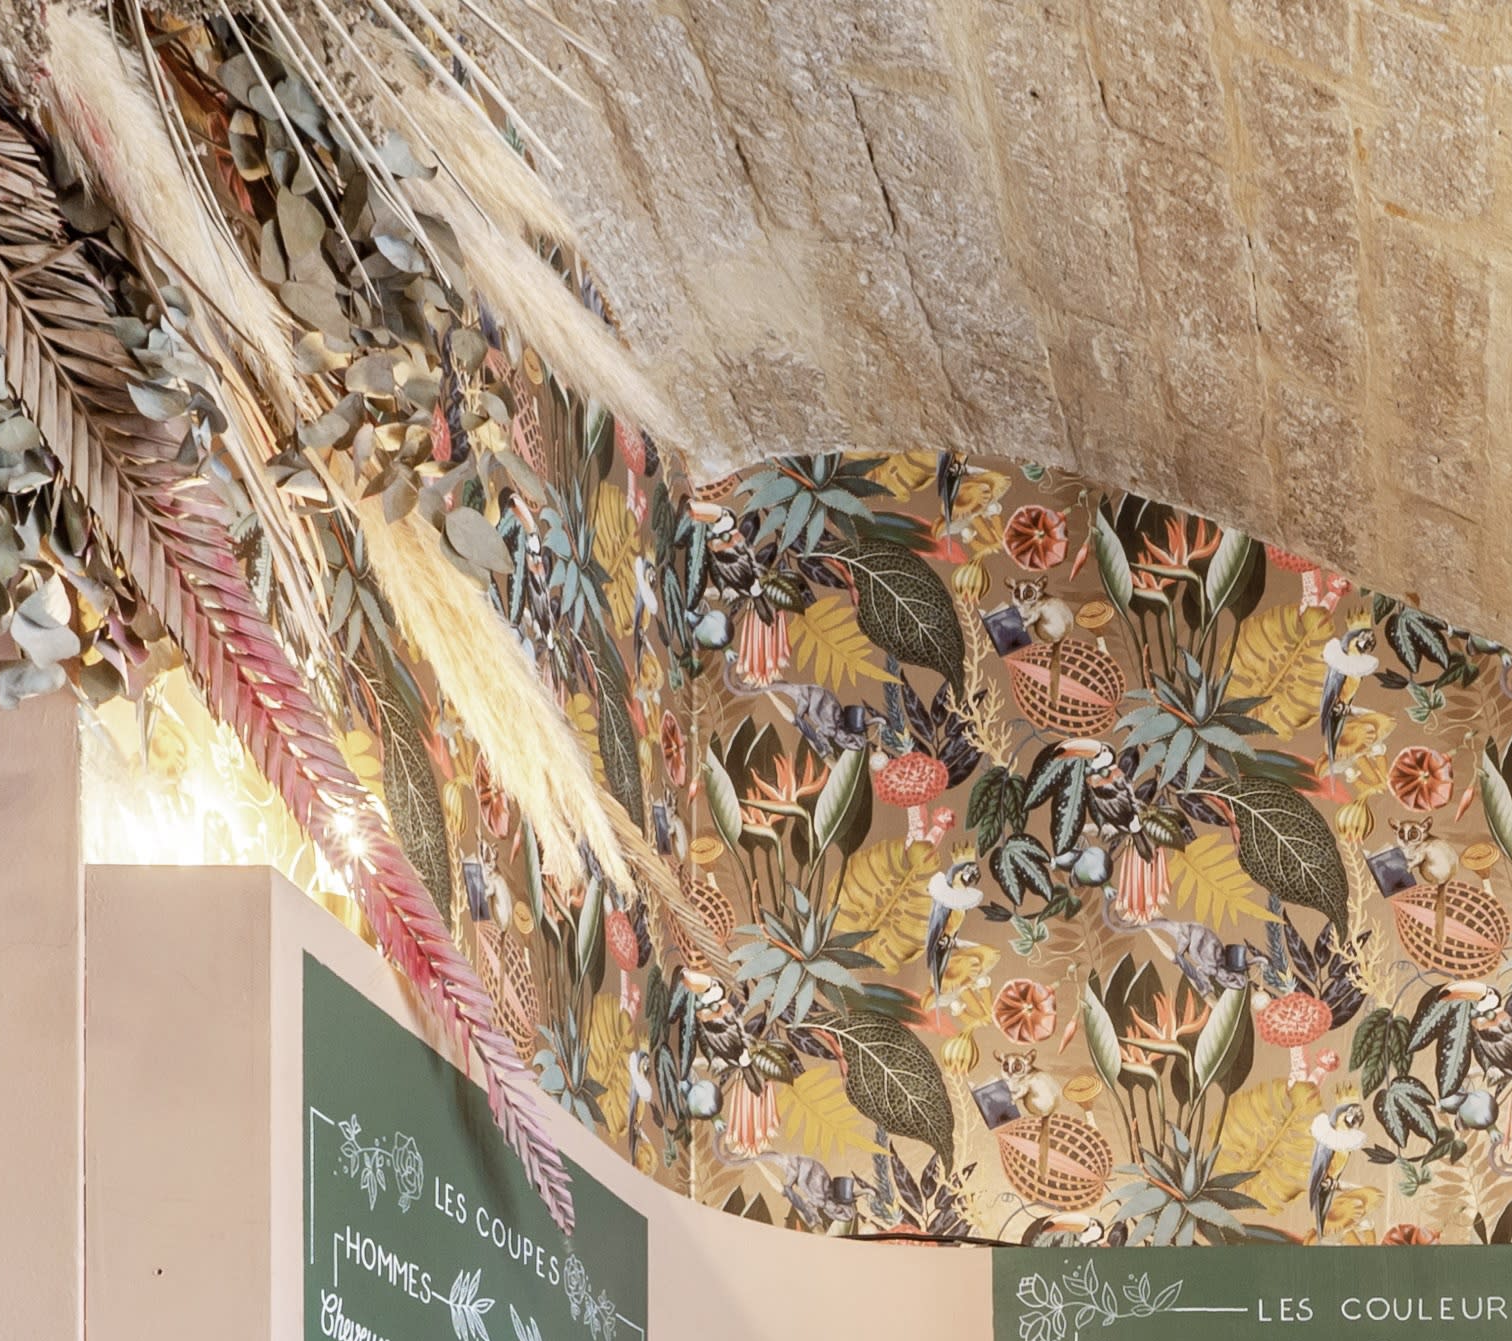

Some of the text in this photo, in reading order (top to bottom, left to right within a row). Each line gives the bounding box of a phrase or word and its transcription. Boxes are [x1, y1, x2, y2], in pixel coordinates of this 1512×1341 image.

[345, 1225, 432, 1305] HOMMES
[434, 1175, 561, 1287] LES COUPES
[1258, 1297, 1314, 1322] LES
